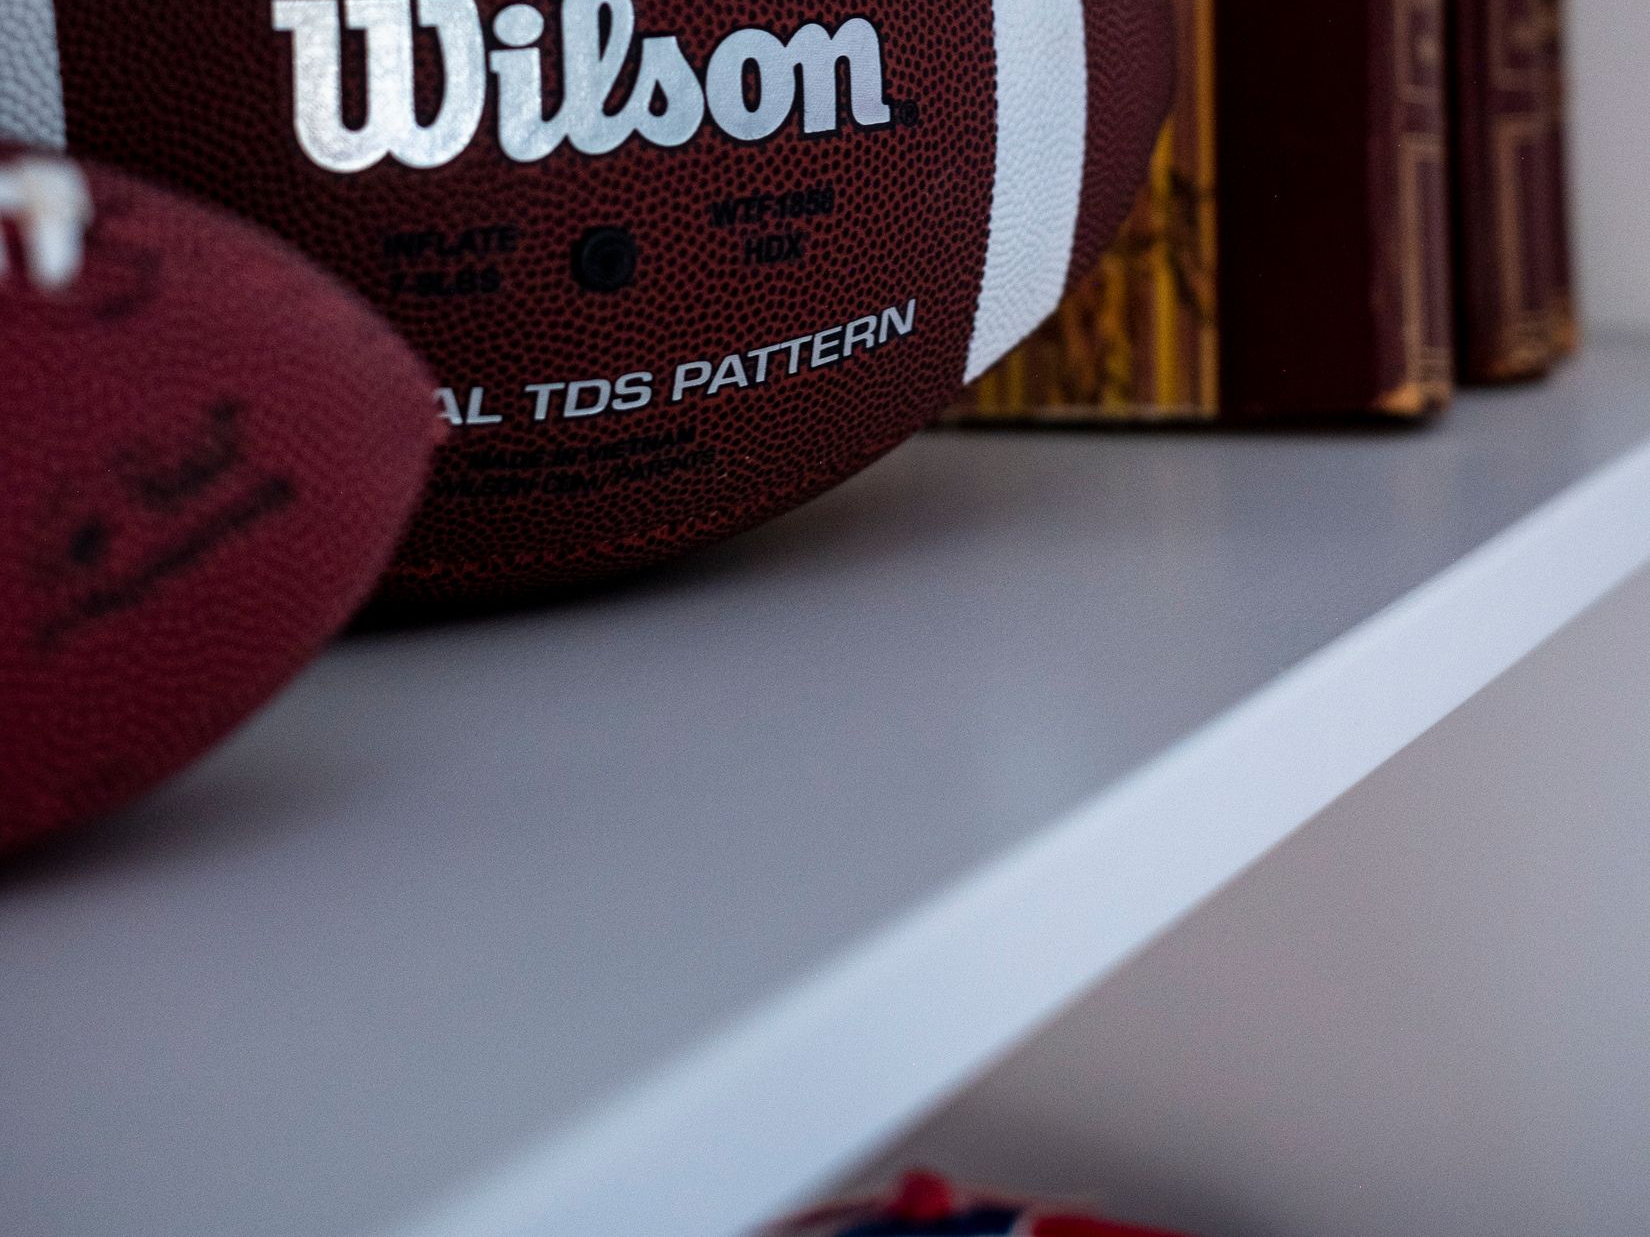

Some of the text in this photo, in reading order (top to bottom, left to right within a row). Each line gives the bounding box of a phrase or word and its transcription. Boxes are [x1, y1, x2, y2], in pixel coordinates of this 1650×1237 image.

[384, 225, 518, 257] INFLATE
[744, 232, 803, 265] HDX
[524, 371, 652, 420] TDS
[671, 298, 917, 401] PATTERN
[586, 426, 696, 460] VIETNAM
